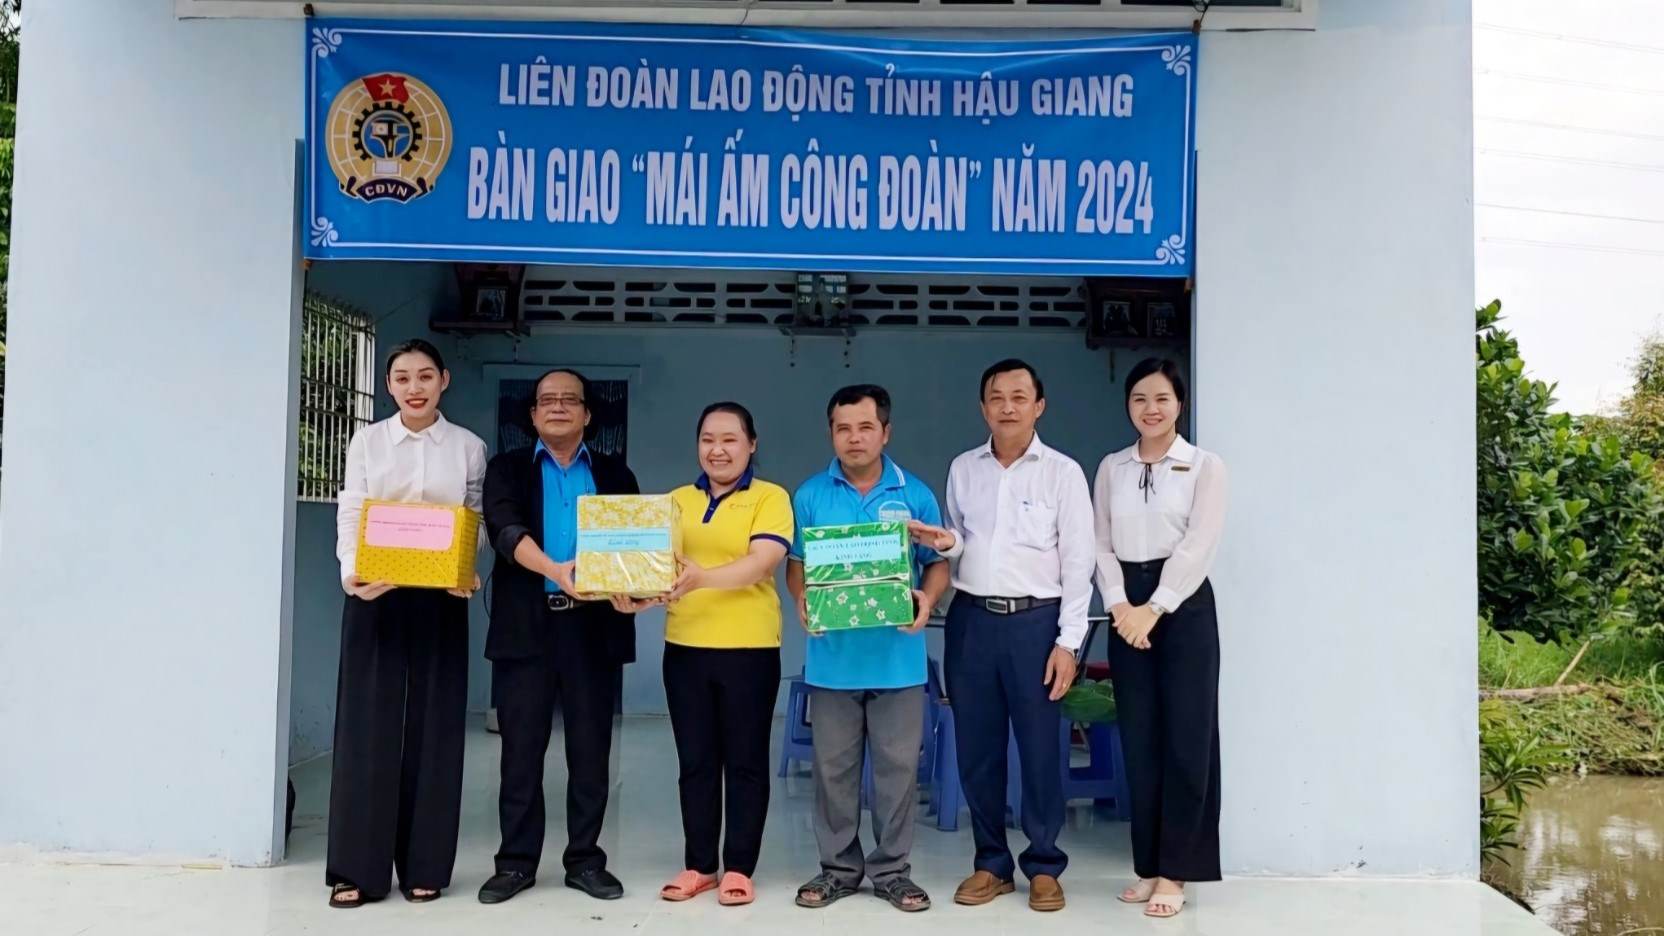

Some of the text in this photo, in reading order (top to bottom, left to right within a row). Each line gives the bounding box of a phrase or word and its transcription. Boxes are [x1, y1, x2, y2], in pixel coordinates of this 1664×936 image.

[499, 55, 1134, 124] LIÊN ĐOÀN LAO ĐỘNG TỈNH HẬU GIANG
[467, 131, 535, 220] BÀN
[546, 147, 620, 225] GIAO
[716, 129, 769, 227] ẤM
[780, 138, 868, 229] CÔNG
[992, 143, 1067, 233] NĂM
[1076, 159, 1154, 234] 2024
